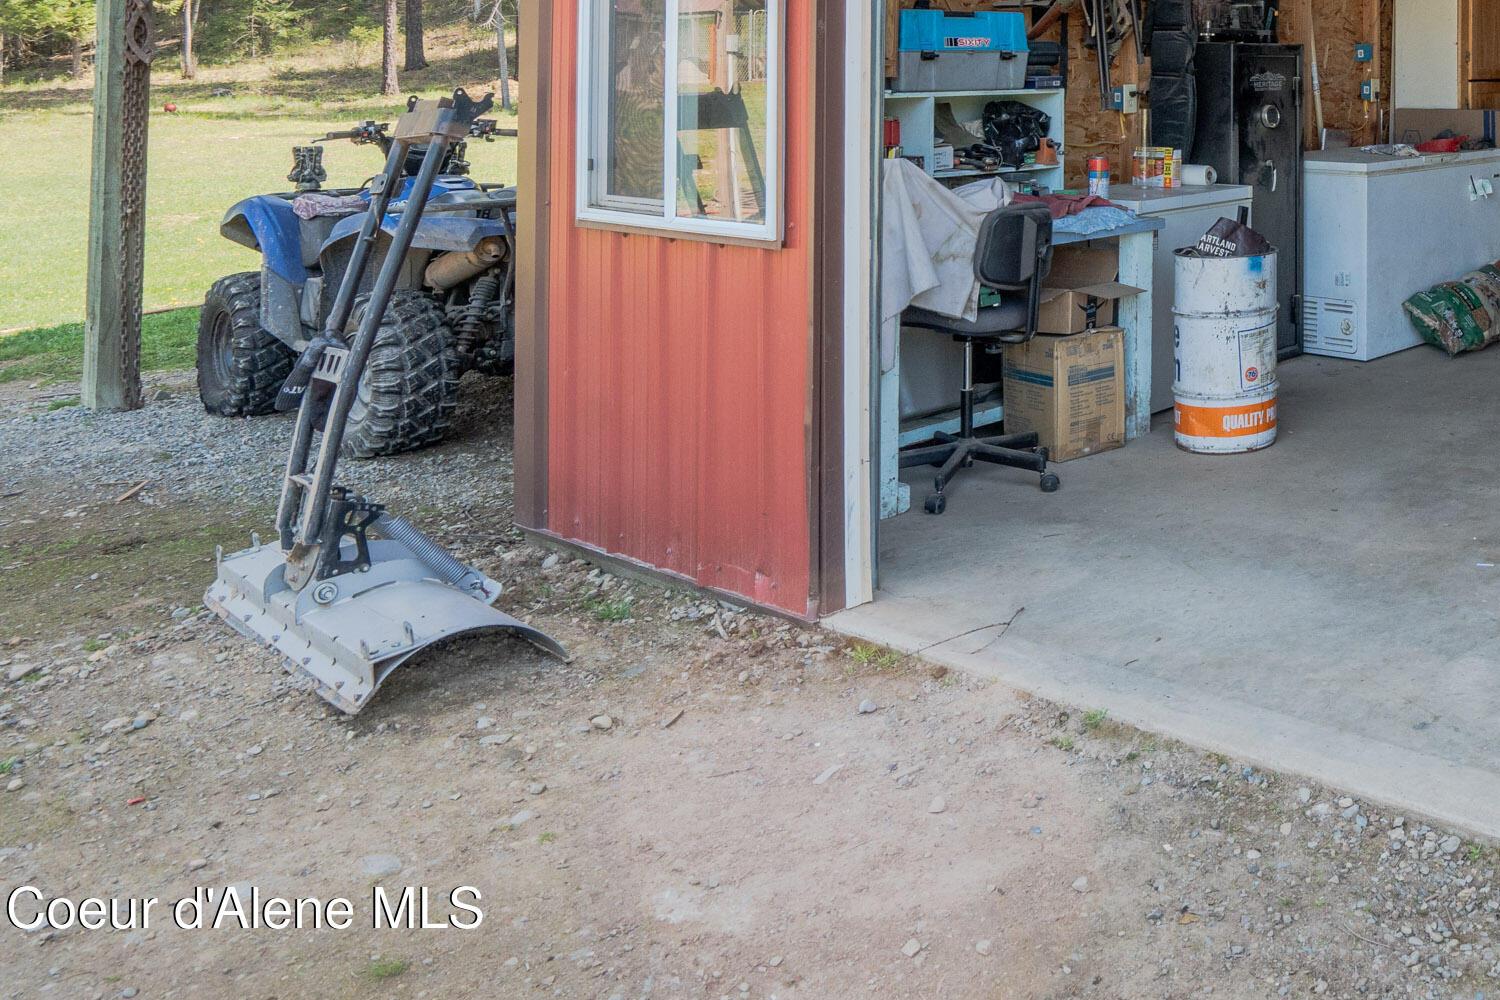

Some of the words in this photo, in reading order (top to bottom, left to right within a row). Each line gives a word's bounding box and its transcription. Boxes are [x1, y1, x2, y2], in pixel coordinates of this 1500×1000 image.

[958, 37, 991, 47] SIXITY
[1200, 234, 1237, 252] ARTLAND
[1222, 410, 1265, 432] QUALITY
